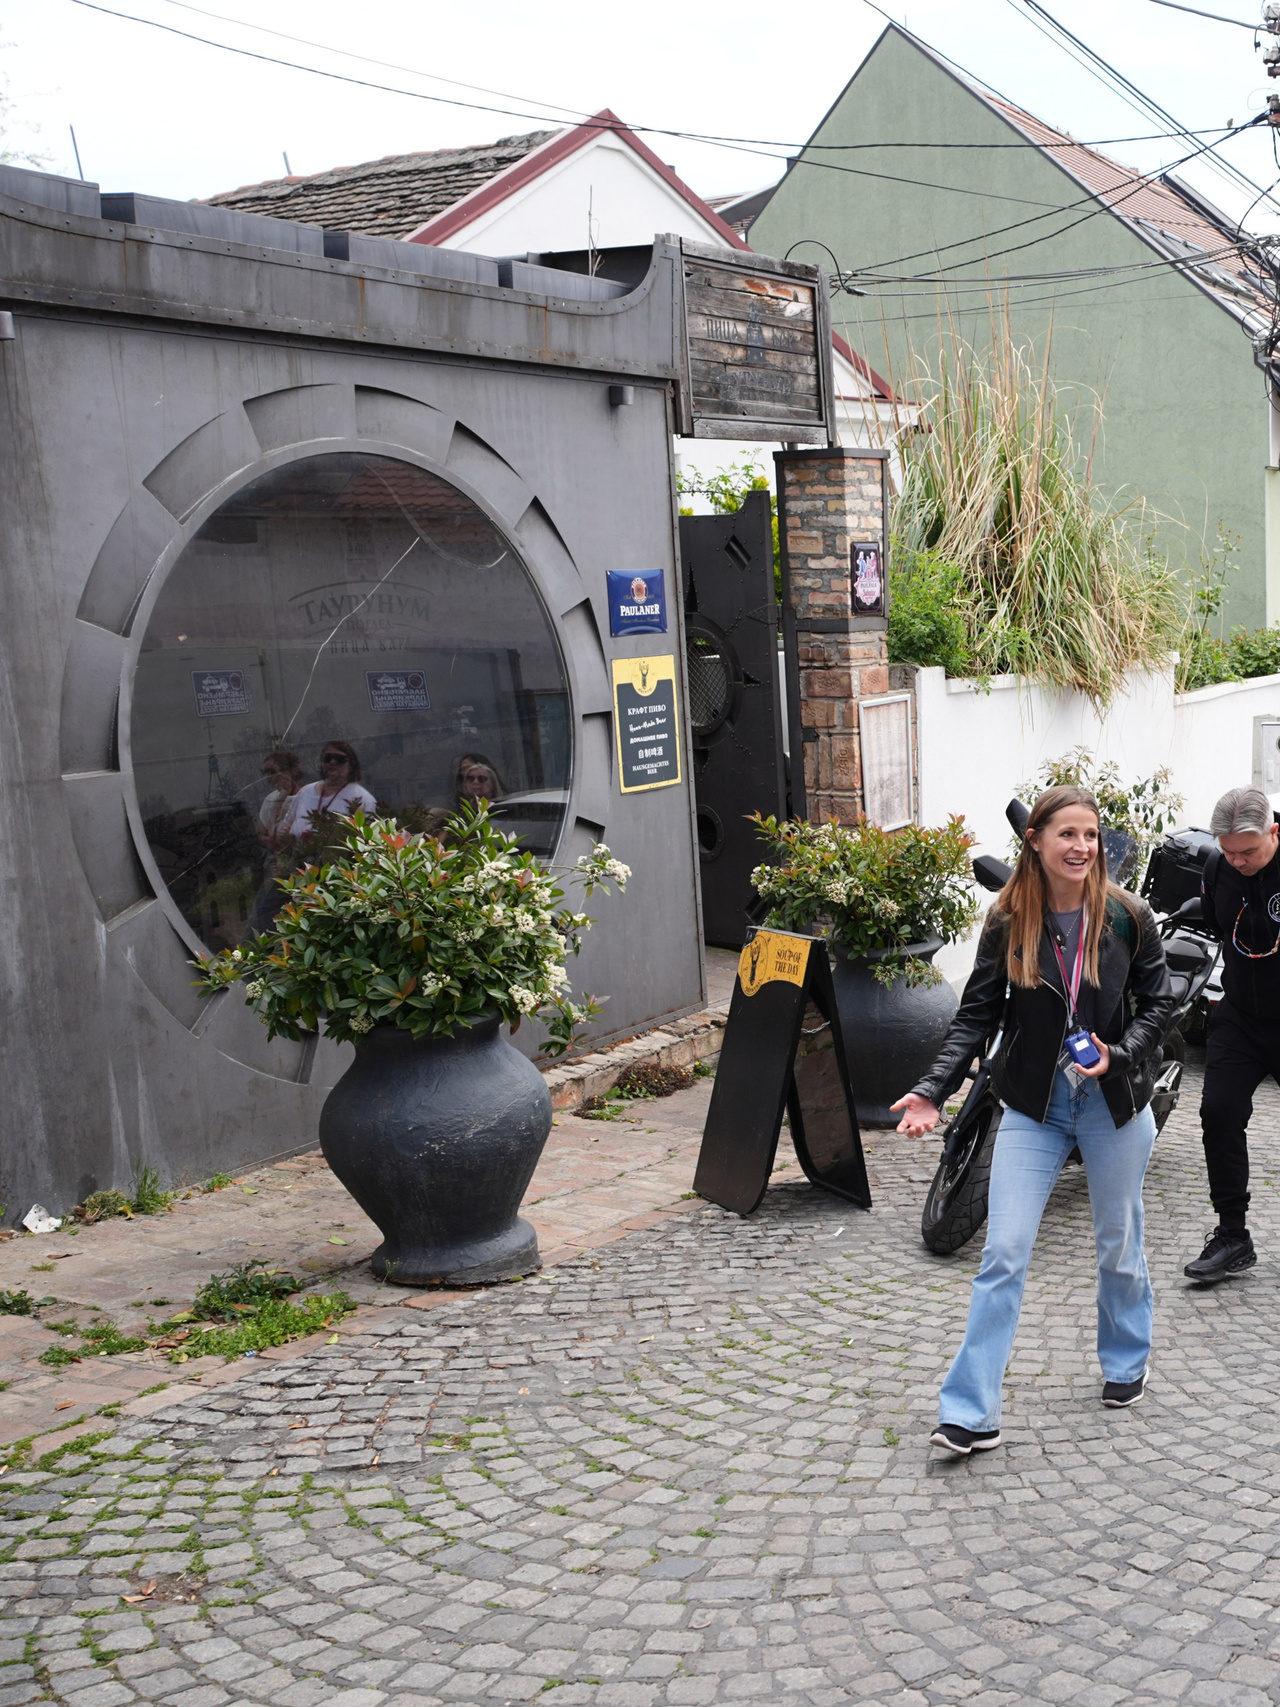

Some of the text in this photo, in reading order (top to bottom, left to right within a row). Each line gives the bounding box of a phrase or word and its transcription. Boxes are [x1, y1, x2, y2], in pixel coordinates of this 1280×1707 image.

[297, 593, 430, 625] ТАУРУНУМ
[620, 604, 660, 617] PAULANER
[330, 639, 370, 655] ПИЦА
[627, 704, 667, 716] КРАФТ ПИВО
[776, 949, 802, 963] SOUP OF
[774, 961, 800, 976] THE DAY
